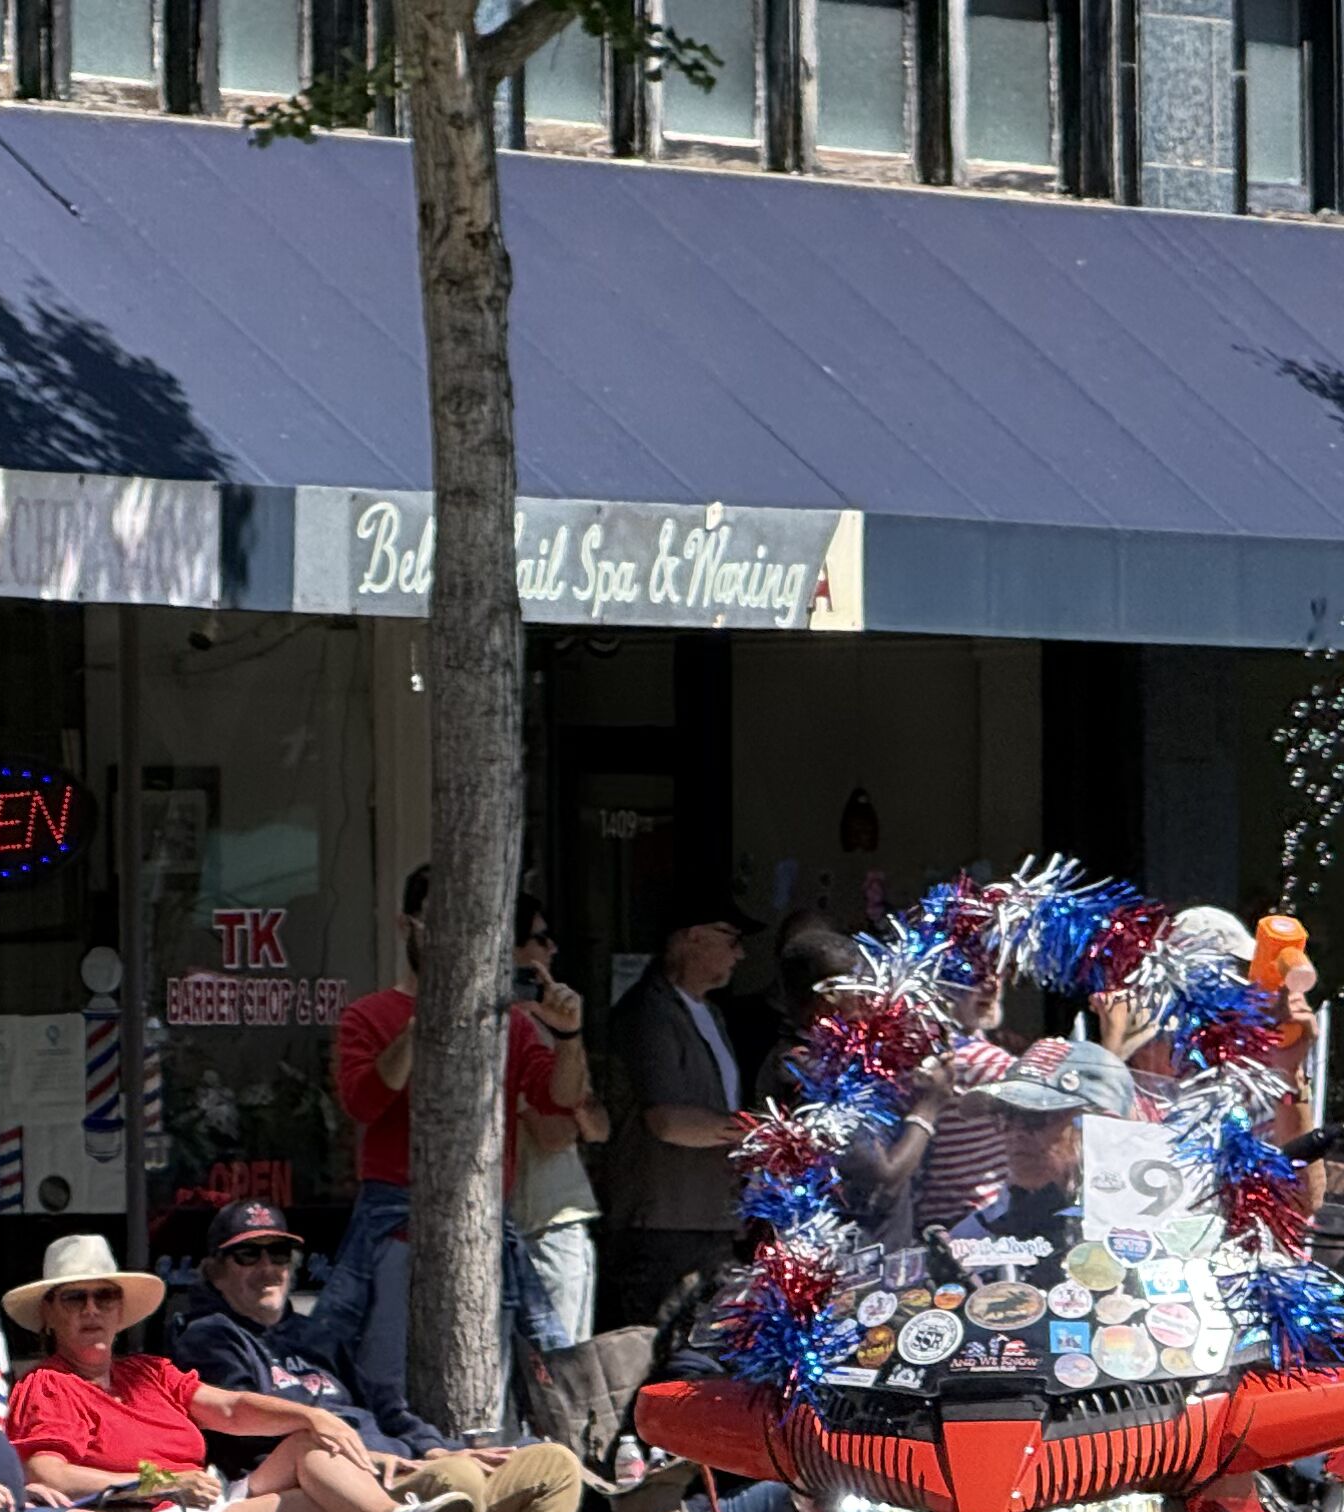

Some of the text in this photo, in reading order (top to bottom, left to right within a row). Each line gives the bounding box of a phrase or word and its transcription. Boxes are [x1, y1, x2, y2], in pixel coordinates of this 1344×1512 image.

[356, 501, 808, 629] Bel ail Spa & Waxing
[211, 907, 289, 970] TK
[167, 977, 241, 1026] BARBER
[243, 978, 296, 1026] SHOP
[296, 978, 312, 1026] &
[209, 1160, 293, 1208] OPEN
[1128, 1159, 1184, 1217] 9
